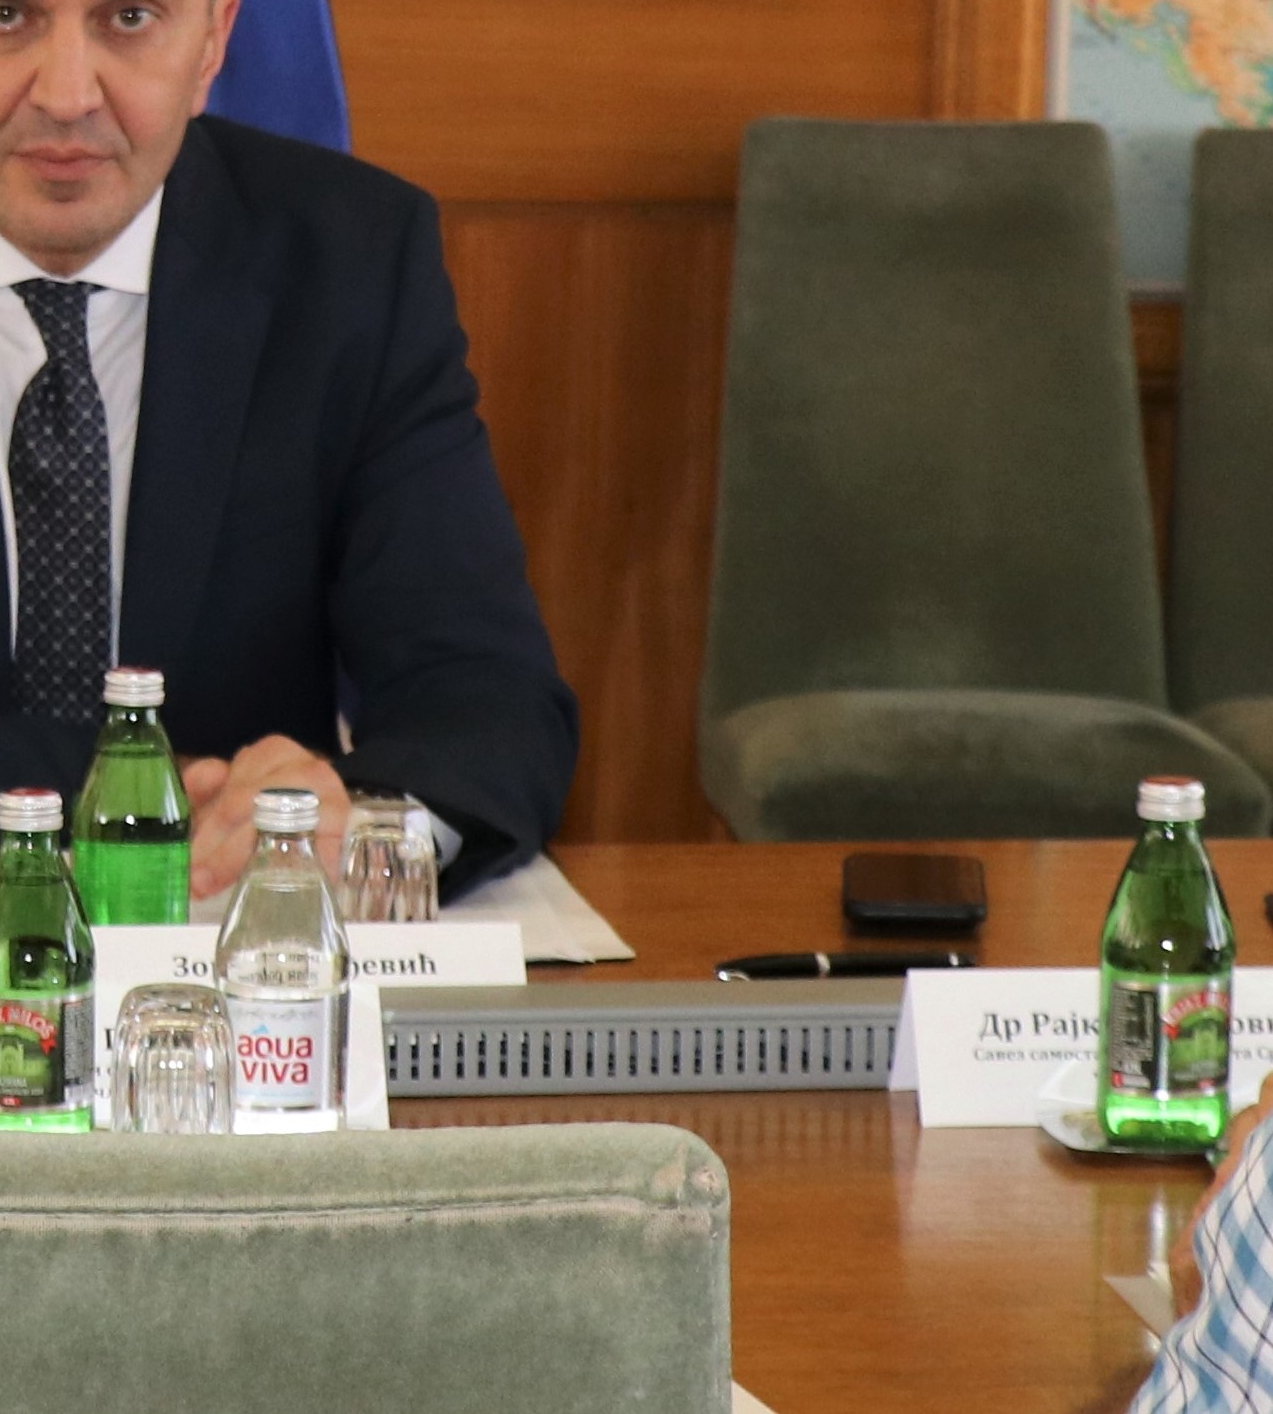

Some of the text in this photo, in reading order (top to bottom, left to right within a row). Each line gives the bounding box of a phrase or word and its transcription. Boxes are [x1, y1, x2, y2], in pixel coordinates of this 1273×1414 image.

[173, 955, 210, 978] Зо
[979, 1012, 1022, 1042] Др
[1031, 1011, 1099, 1041] Рајк
[237, 1035, 313, 1060] aqua
[240, 1060, 310, 1084] viva
